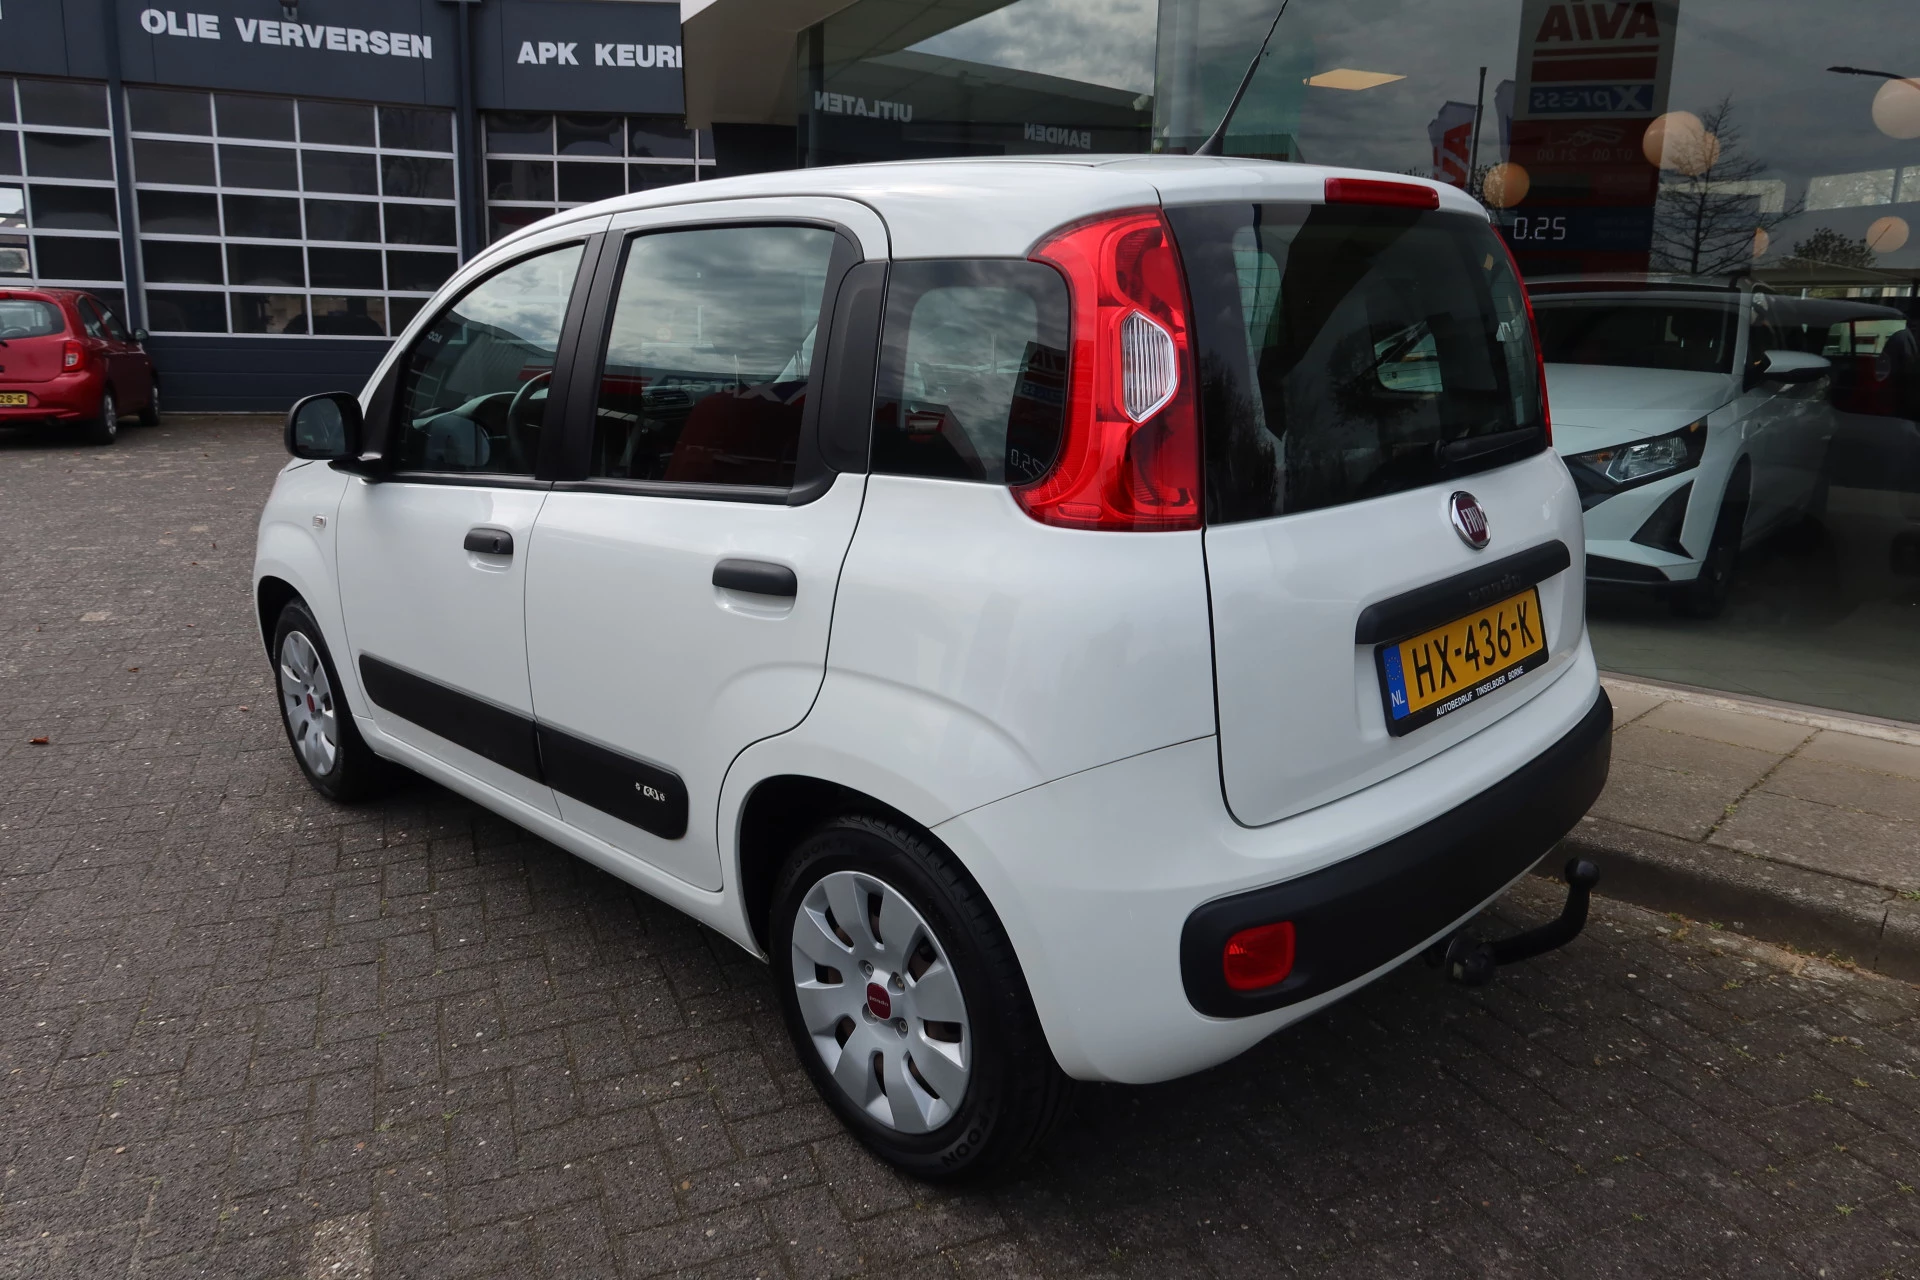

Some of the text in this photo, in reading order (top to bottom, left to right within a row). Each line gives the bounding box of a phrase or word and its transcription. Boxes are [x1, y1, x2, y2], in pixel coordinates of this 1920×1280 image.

[140, 9, 433, 59] OLIE VERVERSEN
[517, 41, 580, 66] APK
[1460, 503, 1486, 535] FIAT
[1411, 601, 1536, 699] HX-436-K
[1391, 689, 1406, 708] NL
[1436, 666, 1525, 717] AUTOBEDRIJF TINSELBOER BORNE
